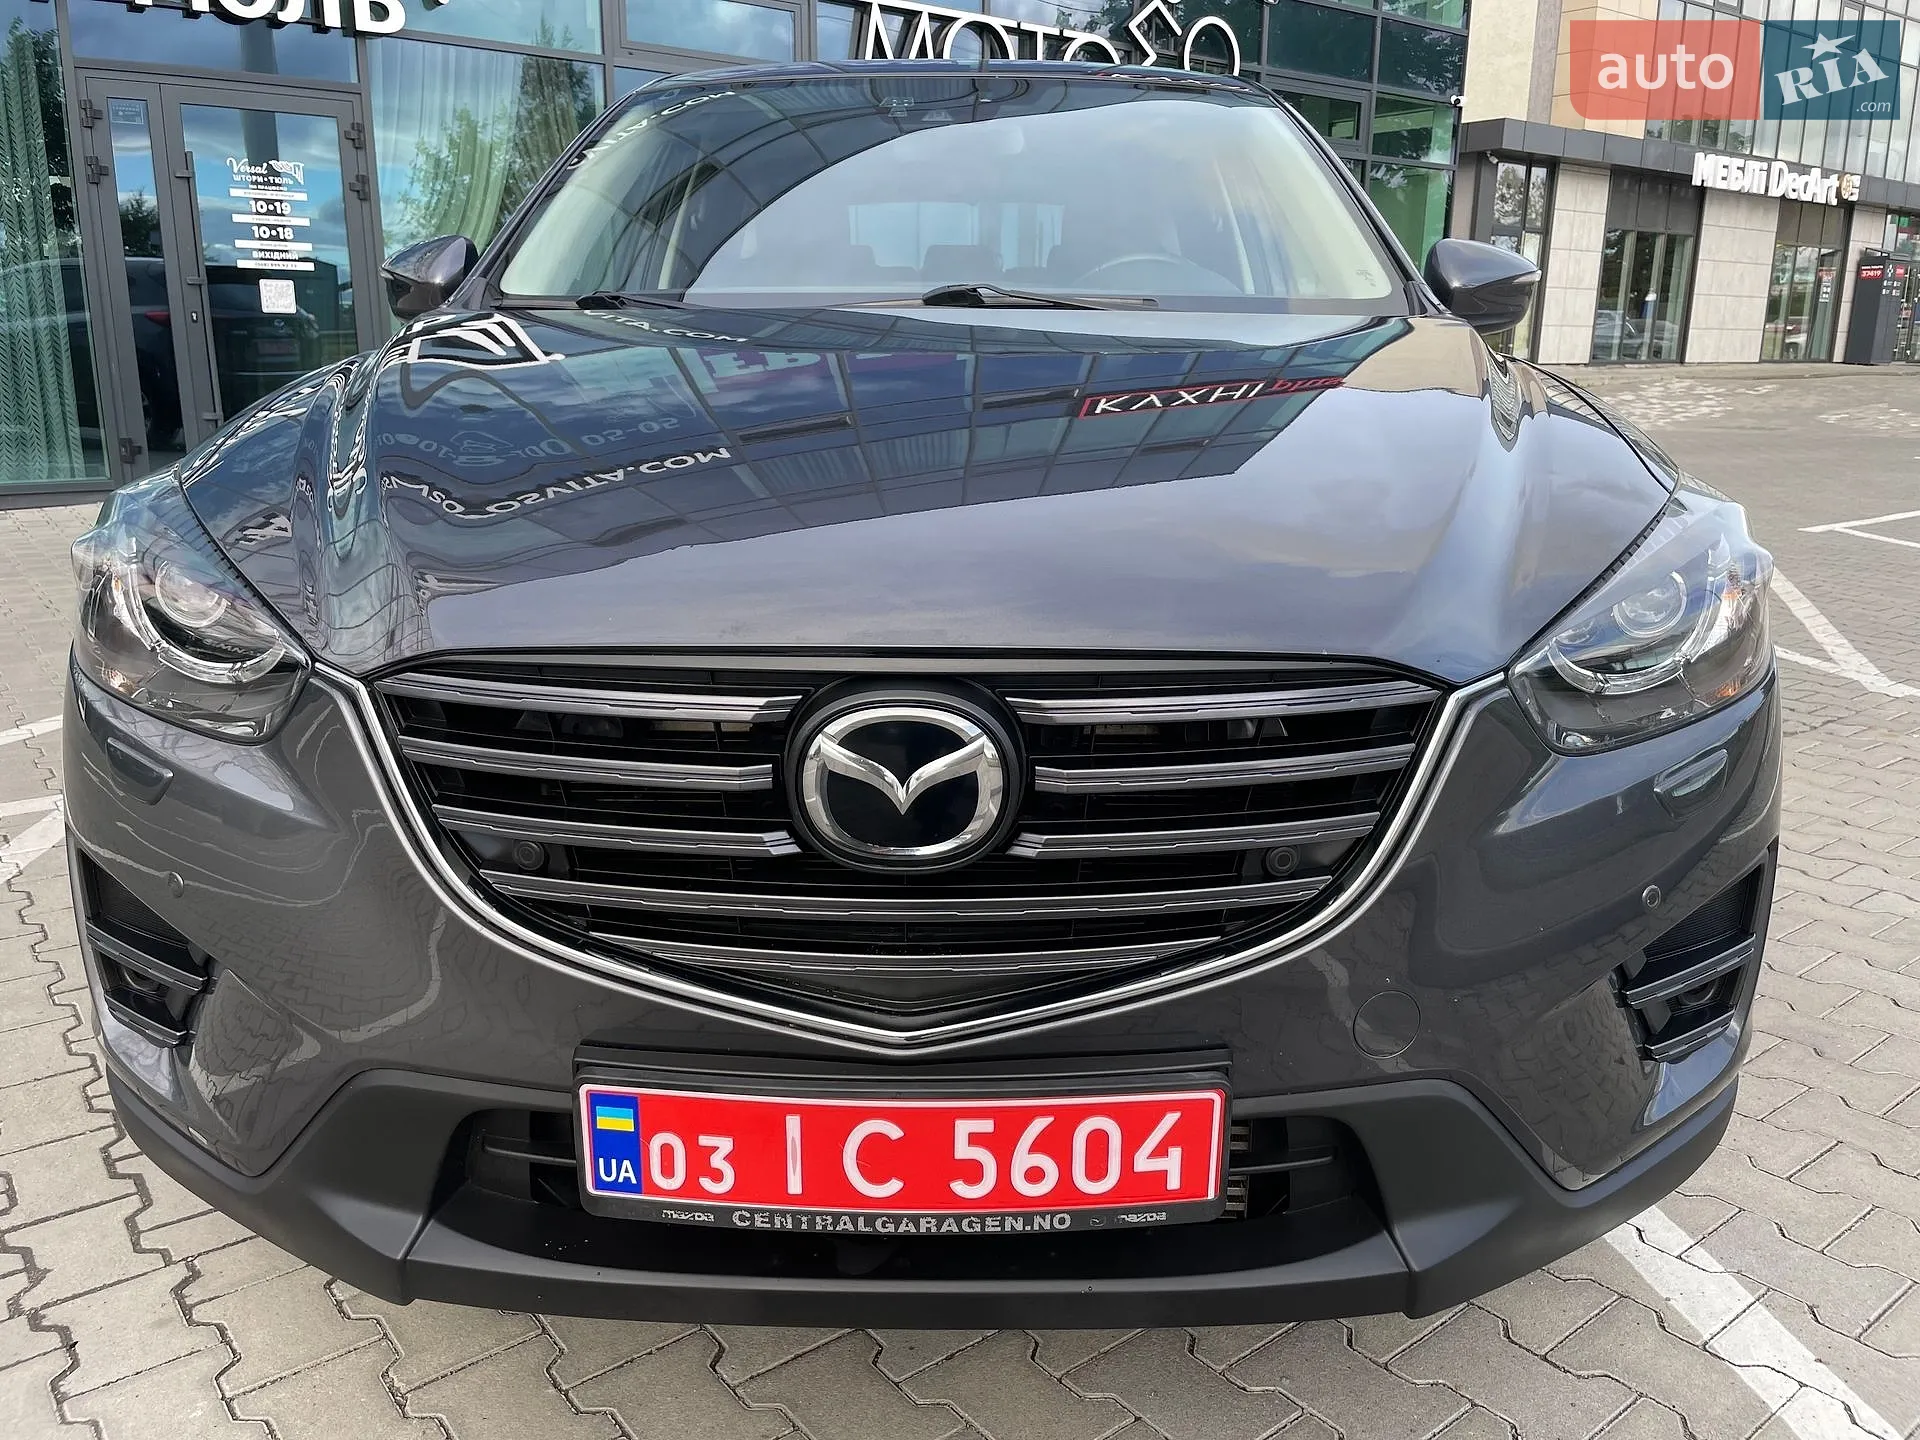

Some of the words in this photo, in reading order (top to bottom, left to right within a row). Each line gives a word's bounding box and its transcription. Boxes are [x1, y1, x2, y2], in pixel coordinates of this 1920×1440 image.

[226, 157, 268, 175] Versal
[650, 1132, 735, 1194] 03
[949, 1111, 1182, 1199] 5604
[598, 1157, 637, 1184] UA
[731, 1209, 1072, 1234] CENTRALGARAGEN.NO
